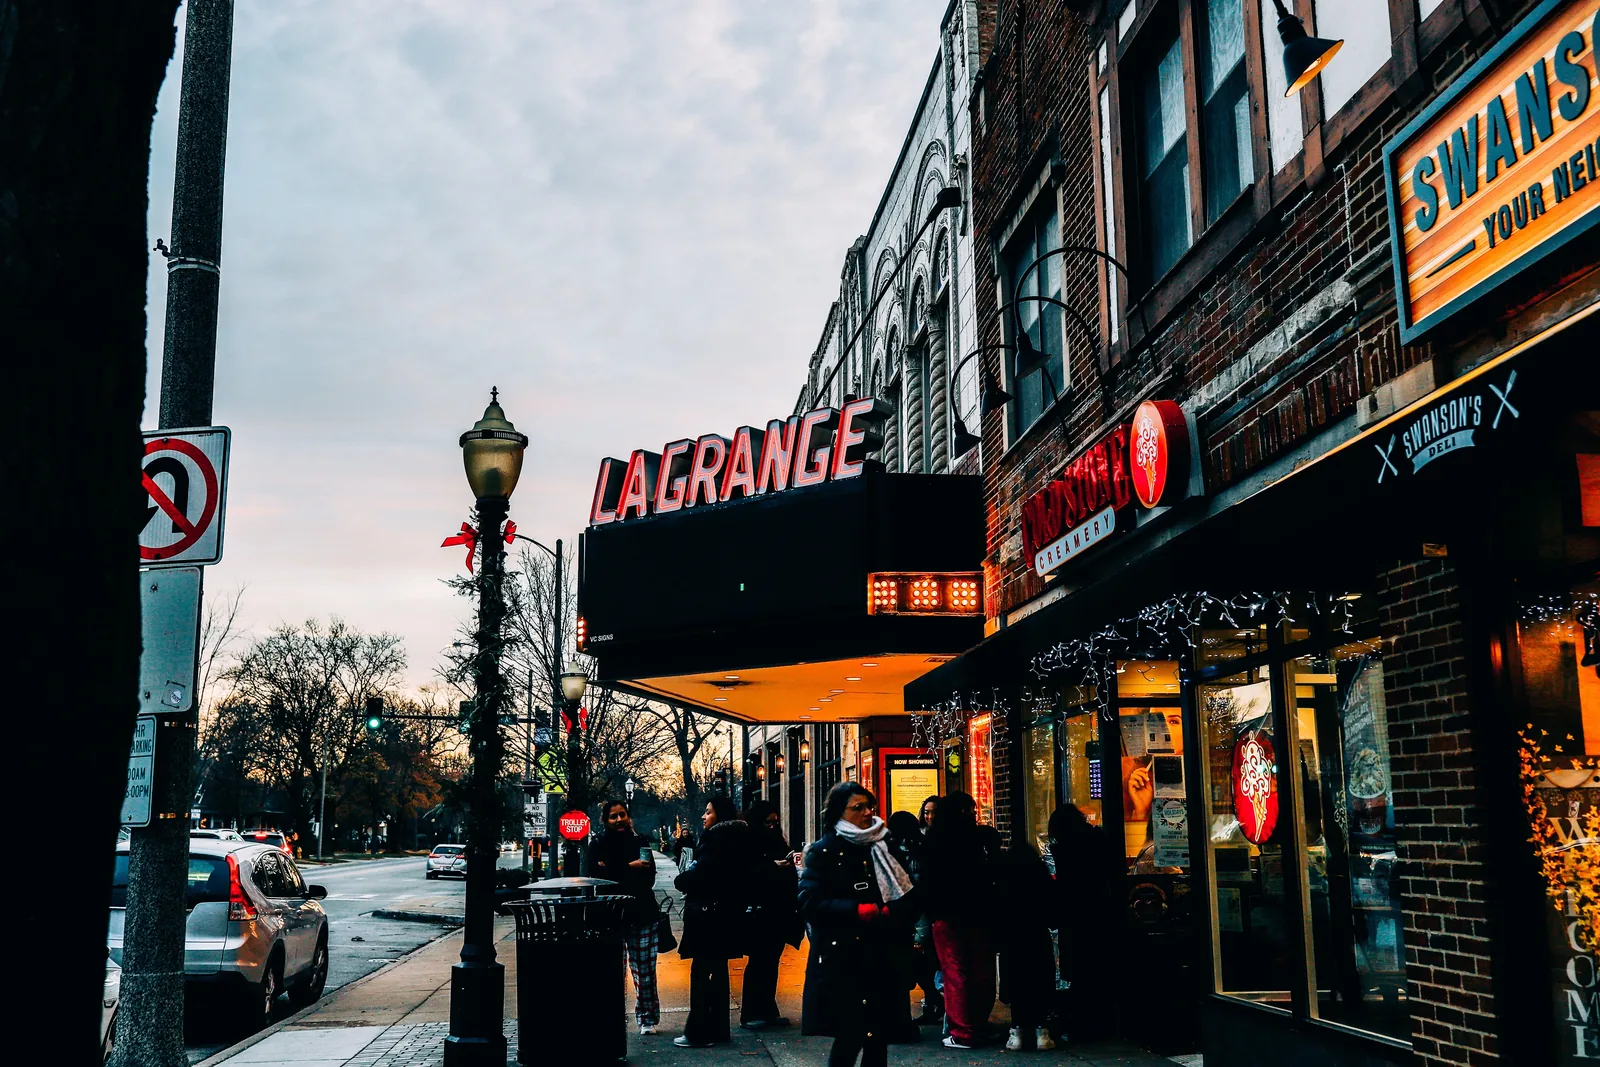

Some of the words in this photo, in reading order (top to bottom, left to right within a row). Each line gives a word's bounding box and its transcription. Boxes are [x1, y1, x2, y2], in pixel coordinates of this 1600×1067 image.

[1412, 8, 1600, 233] SWANS
[1482, 181, 1546, 250] YOUR
[1552, 135, 1600, 204] NEI
[1402, 395, 1482, 459] SWANSON'S
[1428, 436, 1457, 458] DELI
[1039, 513, 1111, 570] CREAMERY
[597, 633, 614, 642] SIGNS
[130, 739, 152, 753] ARKING
[135, 724, 146, 738] HR
[1547, 816, 1600, 1060] WLCOME
